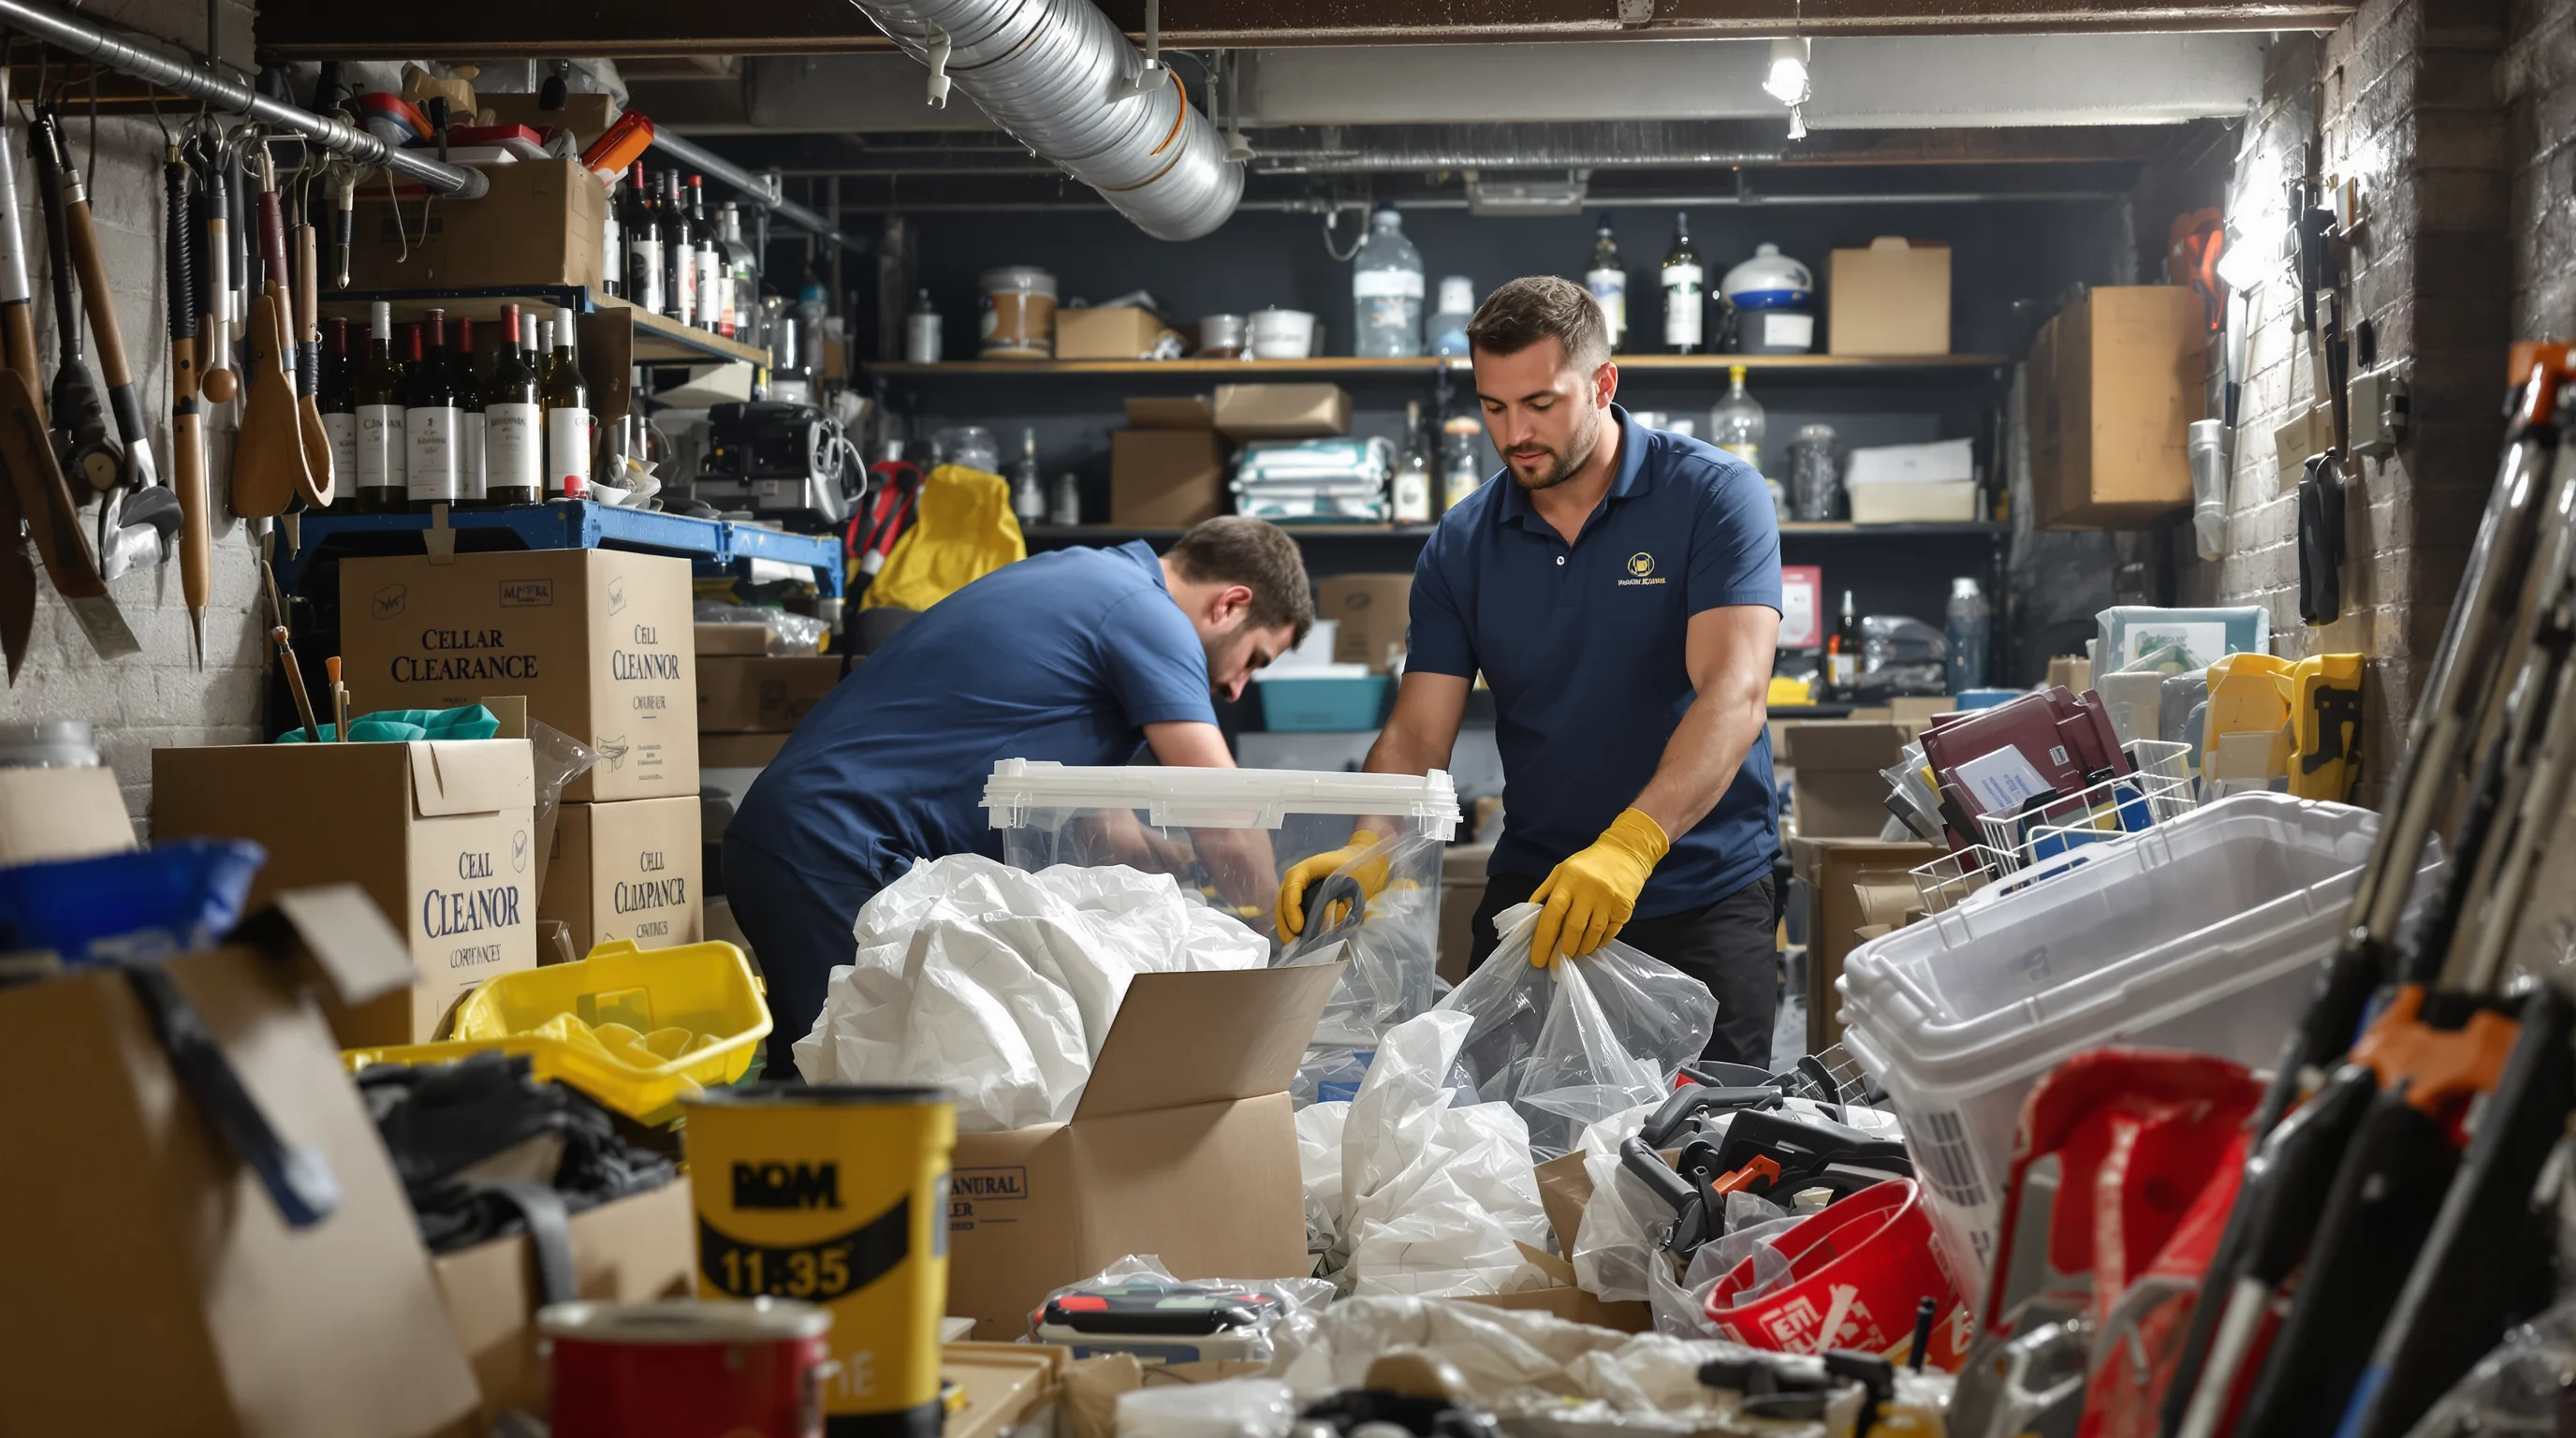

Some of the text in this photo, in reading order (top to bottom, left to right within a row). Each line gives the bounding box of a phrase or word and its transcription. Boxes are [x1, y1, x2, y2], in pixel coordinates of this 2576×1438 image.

[421, 628, 505, 651] CELLAR
[391, 655, 538, 682] CLEARANCE
[423, 886, 520, 939] CLEANOR
